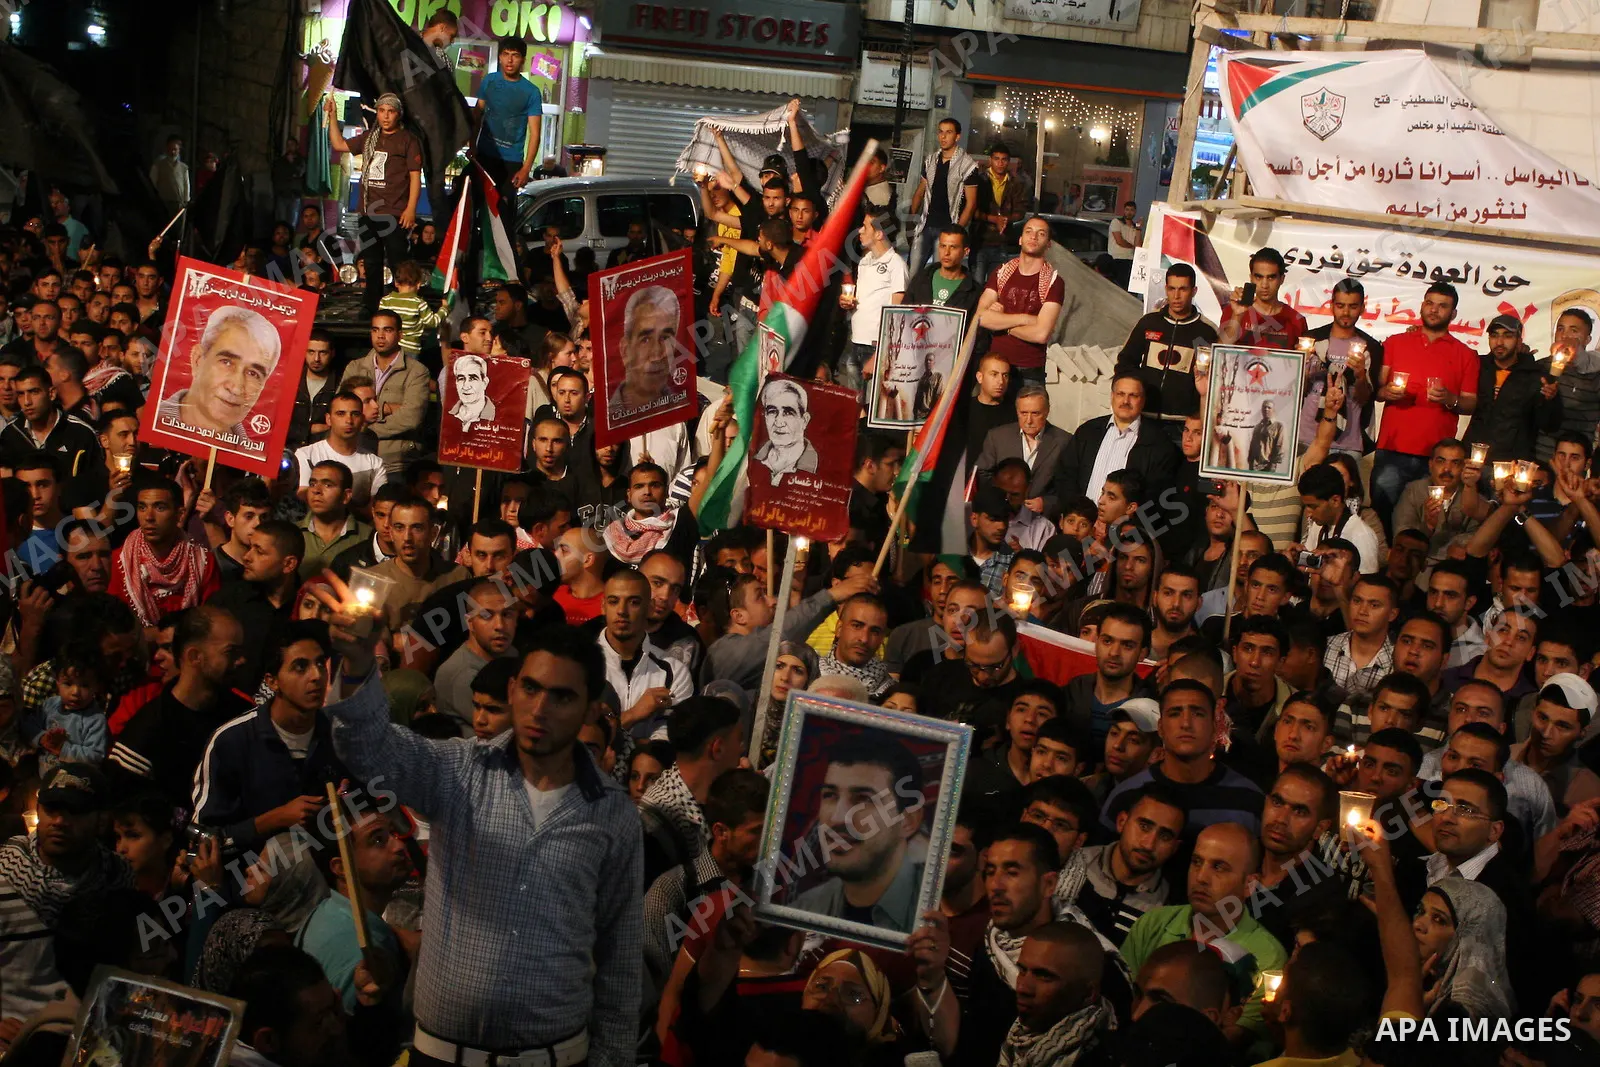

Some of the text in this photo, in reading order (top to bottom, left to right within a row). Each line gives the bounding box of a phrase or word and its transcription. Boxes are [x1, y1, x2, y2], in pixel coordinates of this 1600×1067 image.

[491, 0, 562, 43] aki
[720, 13, 831, 47] STORES
[937, 97, 943, 106] 3
[1373, 94, 1391, 108] فتح
[1401, 94, 1448, 110] الفلسطيني
[1437, 119, 1449, 133] أبو
[1307, 154, 1341, 181] أجل
[1345, 165, 1366, 182] من
[1371, 156, 1414, 184] ثاروا
[1419, 158, 1480, 185] أسرانا
[1504, 165, 1570, 190] البواسل
[1446, 202, 1467, 222] من
[1471, 198, 1527, 224] لنثور
[1283, 244, 1531, 297] حق العودة حق فردي
[205, 282, 296, 315] من يعرف دربك لن يهزم
[1384, 297, 1486, 346] يسط
[161, 415, 196, 433] سعدات
[612, 408, 638, 420] سعدات
[196, 428, 215, 439] احمد
[240, 436, 265, 452] الحرية
[787, 475, 812, 487] غسان
